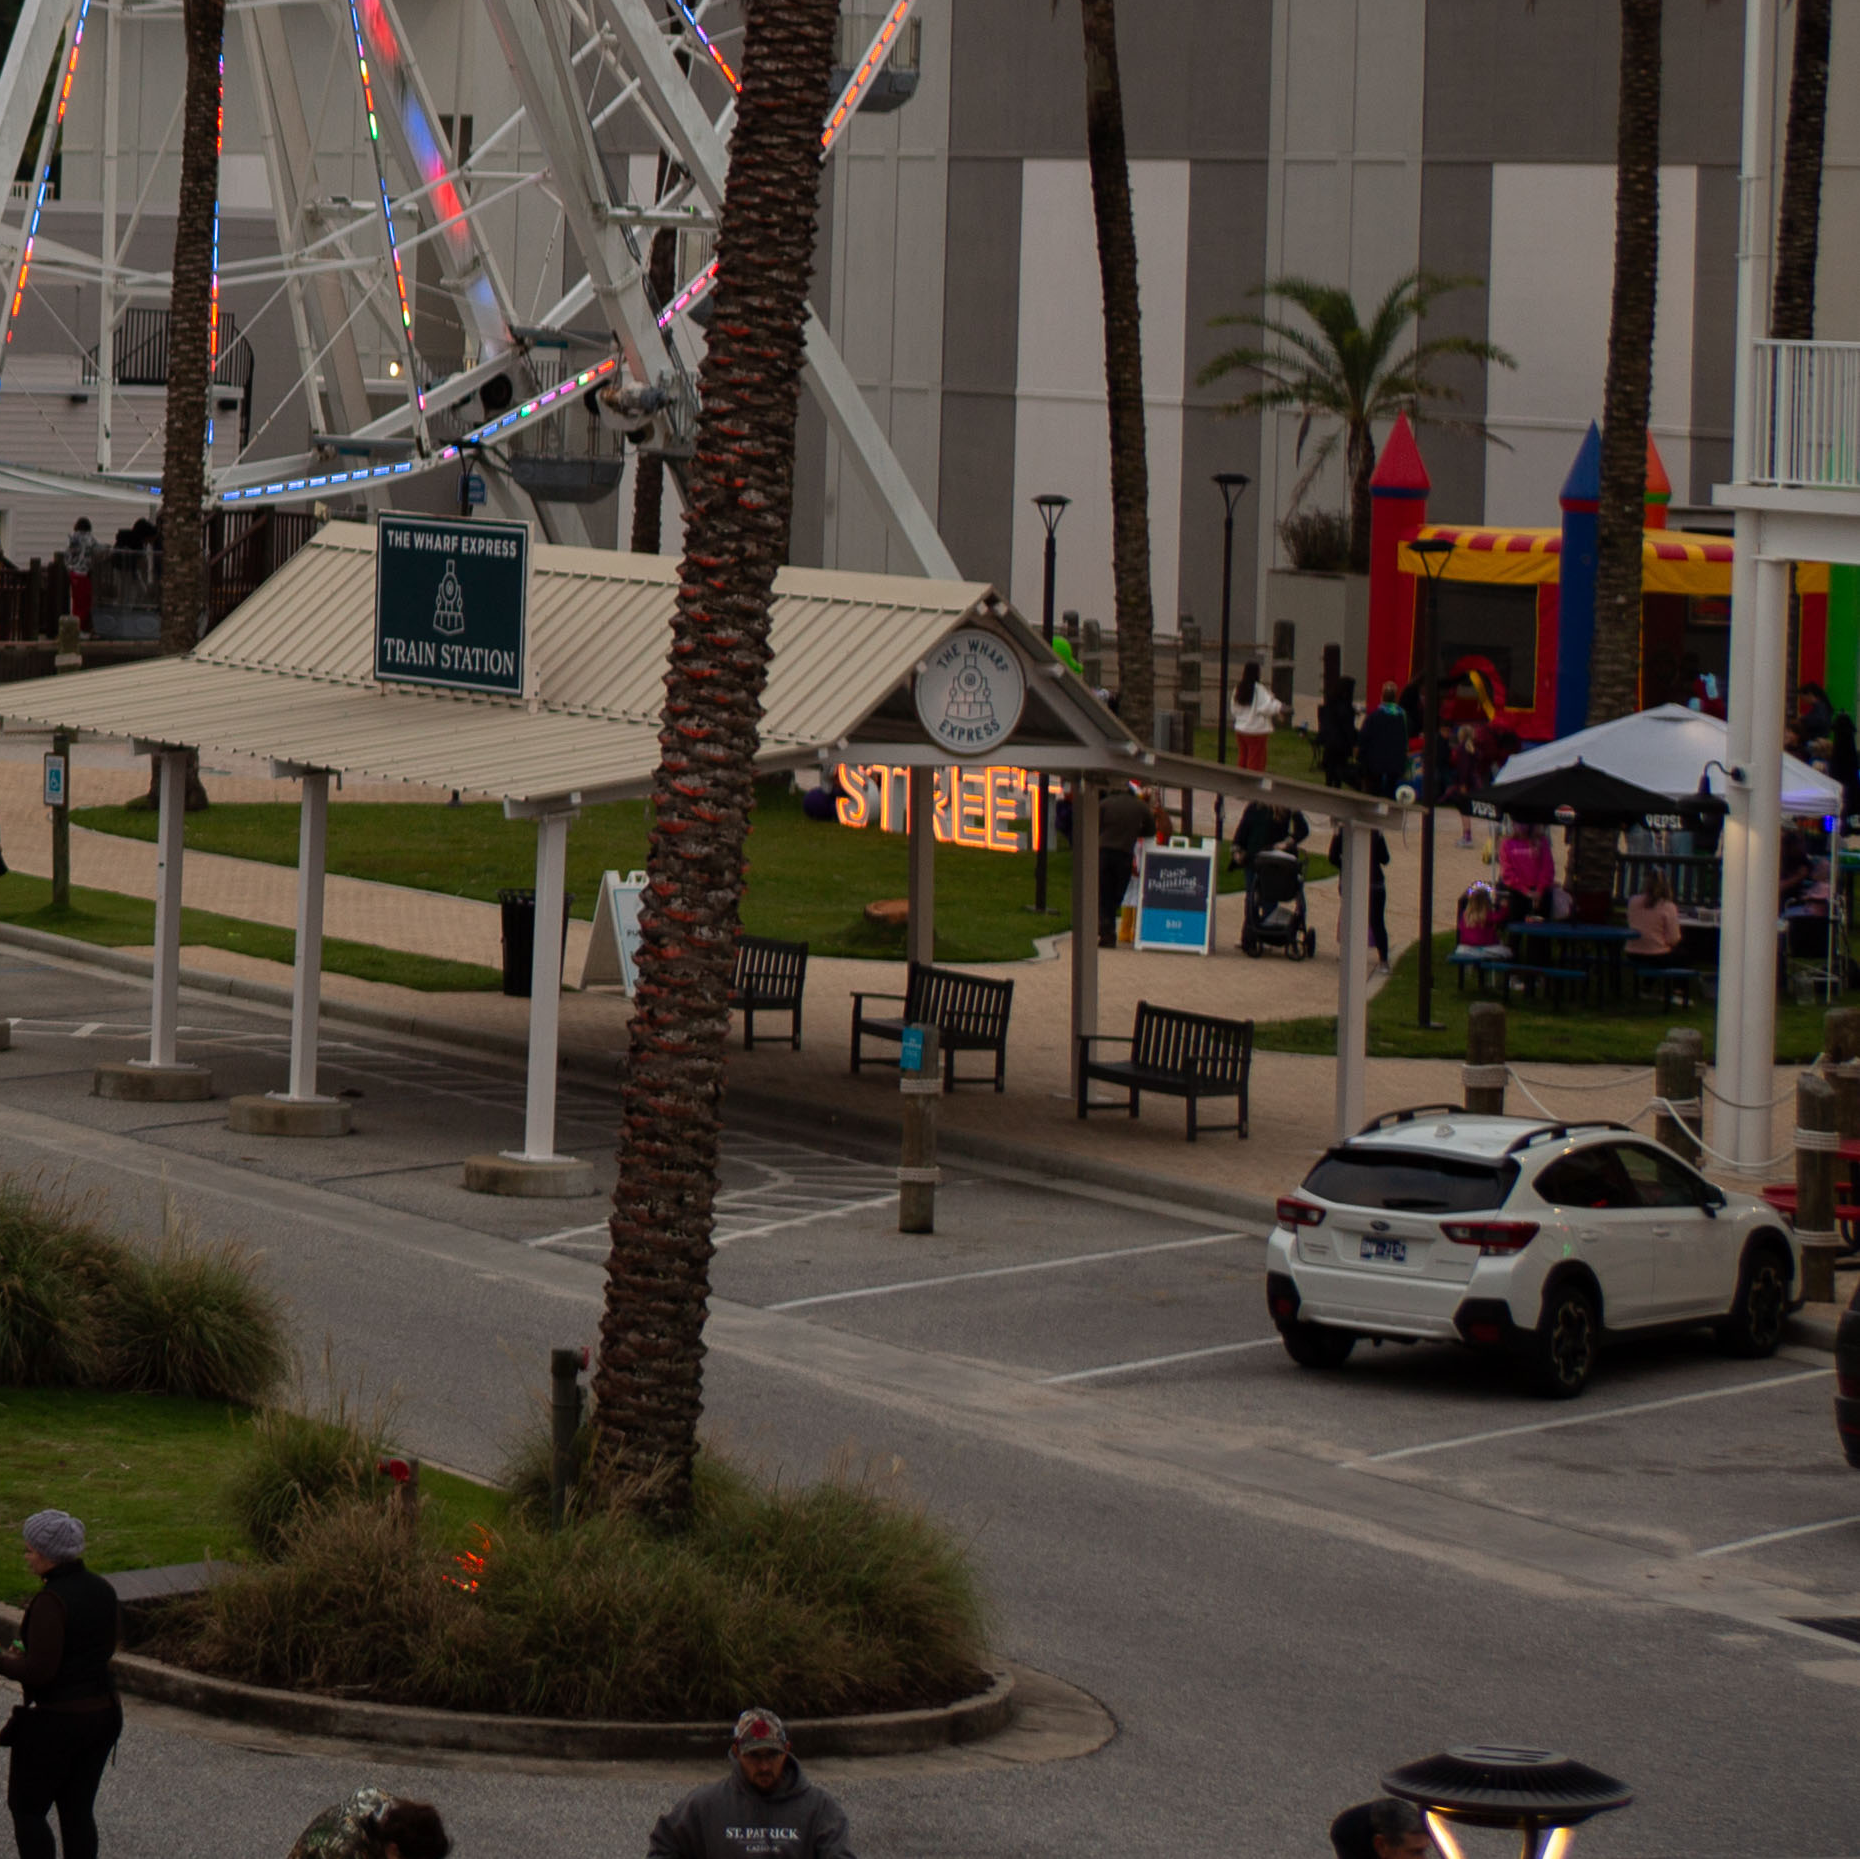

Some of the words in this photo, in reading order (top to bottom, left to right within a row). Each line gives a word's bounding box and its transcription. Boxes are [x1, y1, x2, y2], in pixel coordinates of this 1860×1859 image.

[386, 529, 411, 549] THE
[413, 532, 459, 553] WHARF
[461, 535, 517, 559] EXPRESS
[383, 637, 436, 667] TRAIN
[440, 643, 515, 676] STATION
[937, 643, 960, 669] THE
[967, 639, 1009, 672] WHARF
[939, 718, 1001, 742] EXPRESS
[835, 763, 1063, 853] STREET
[1147, 875, 1198, 891] Painting
